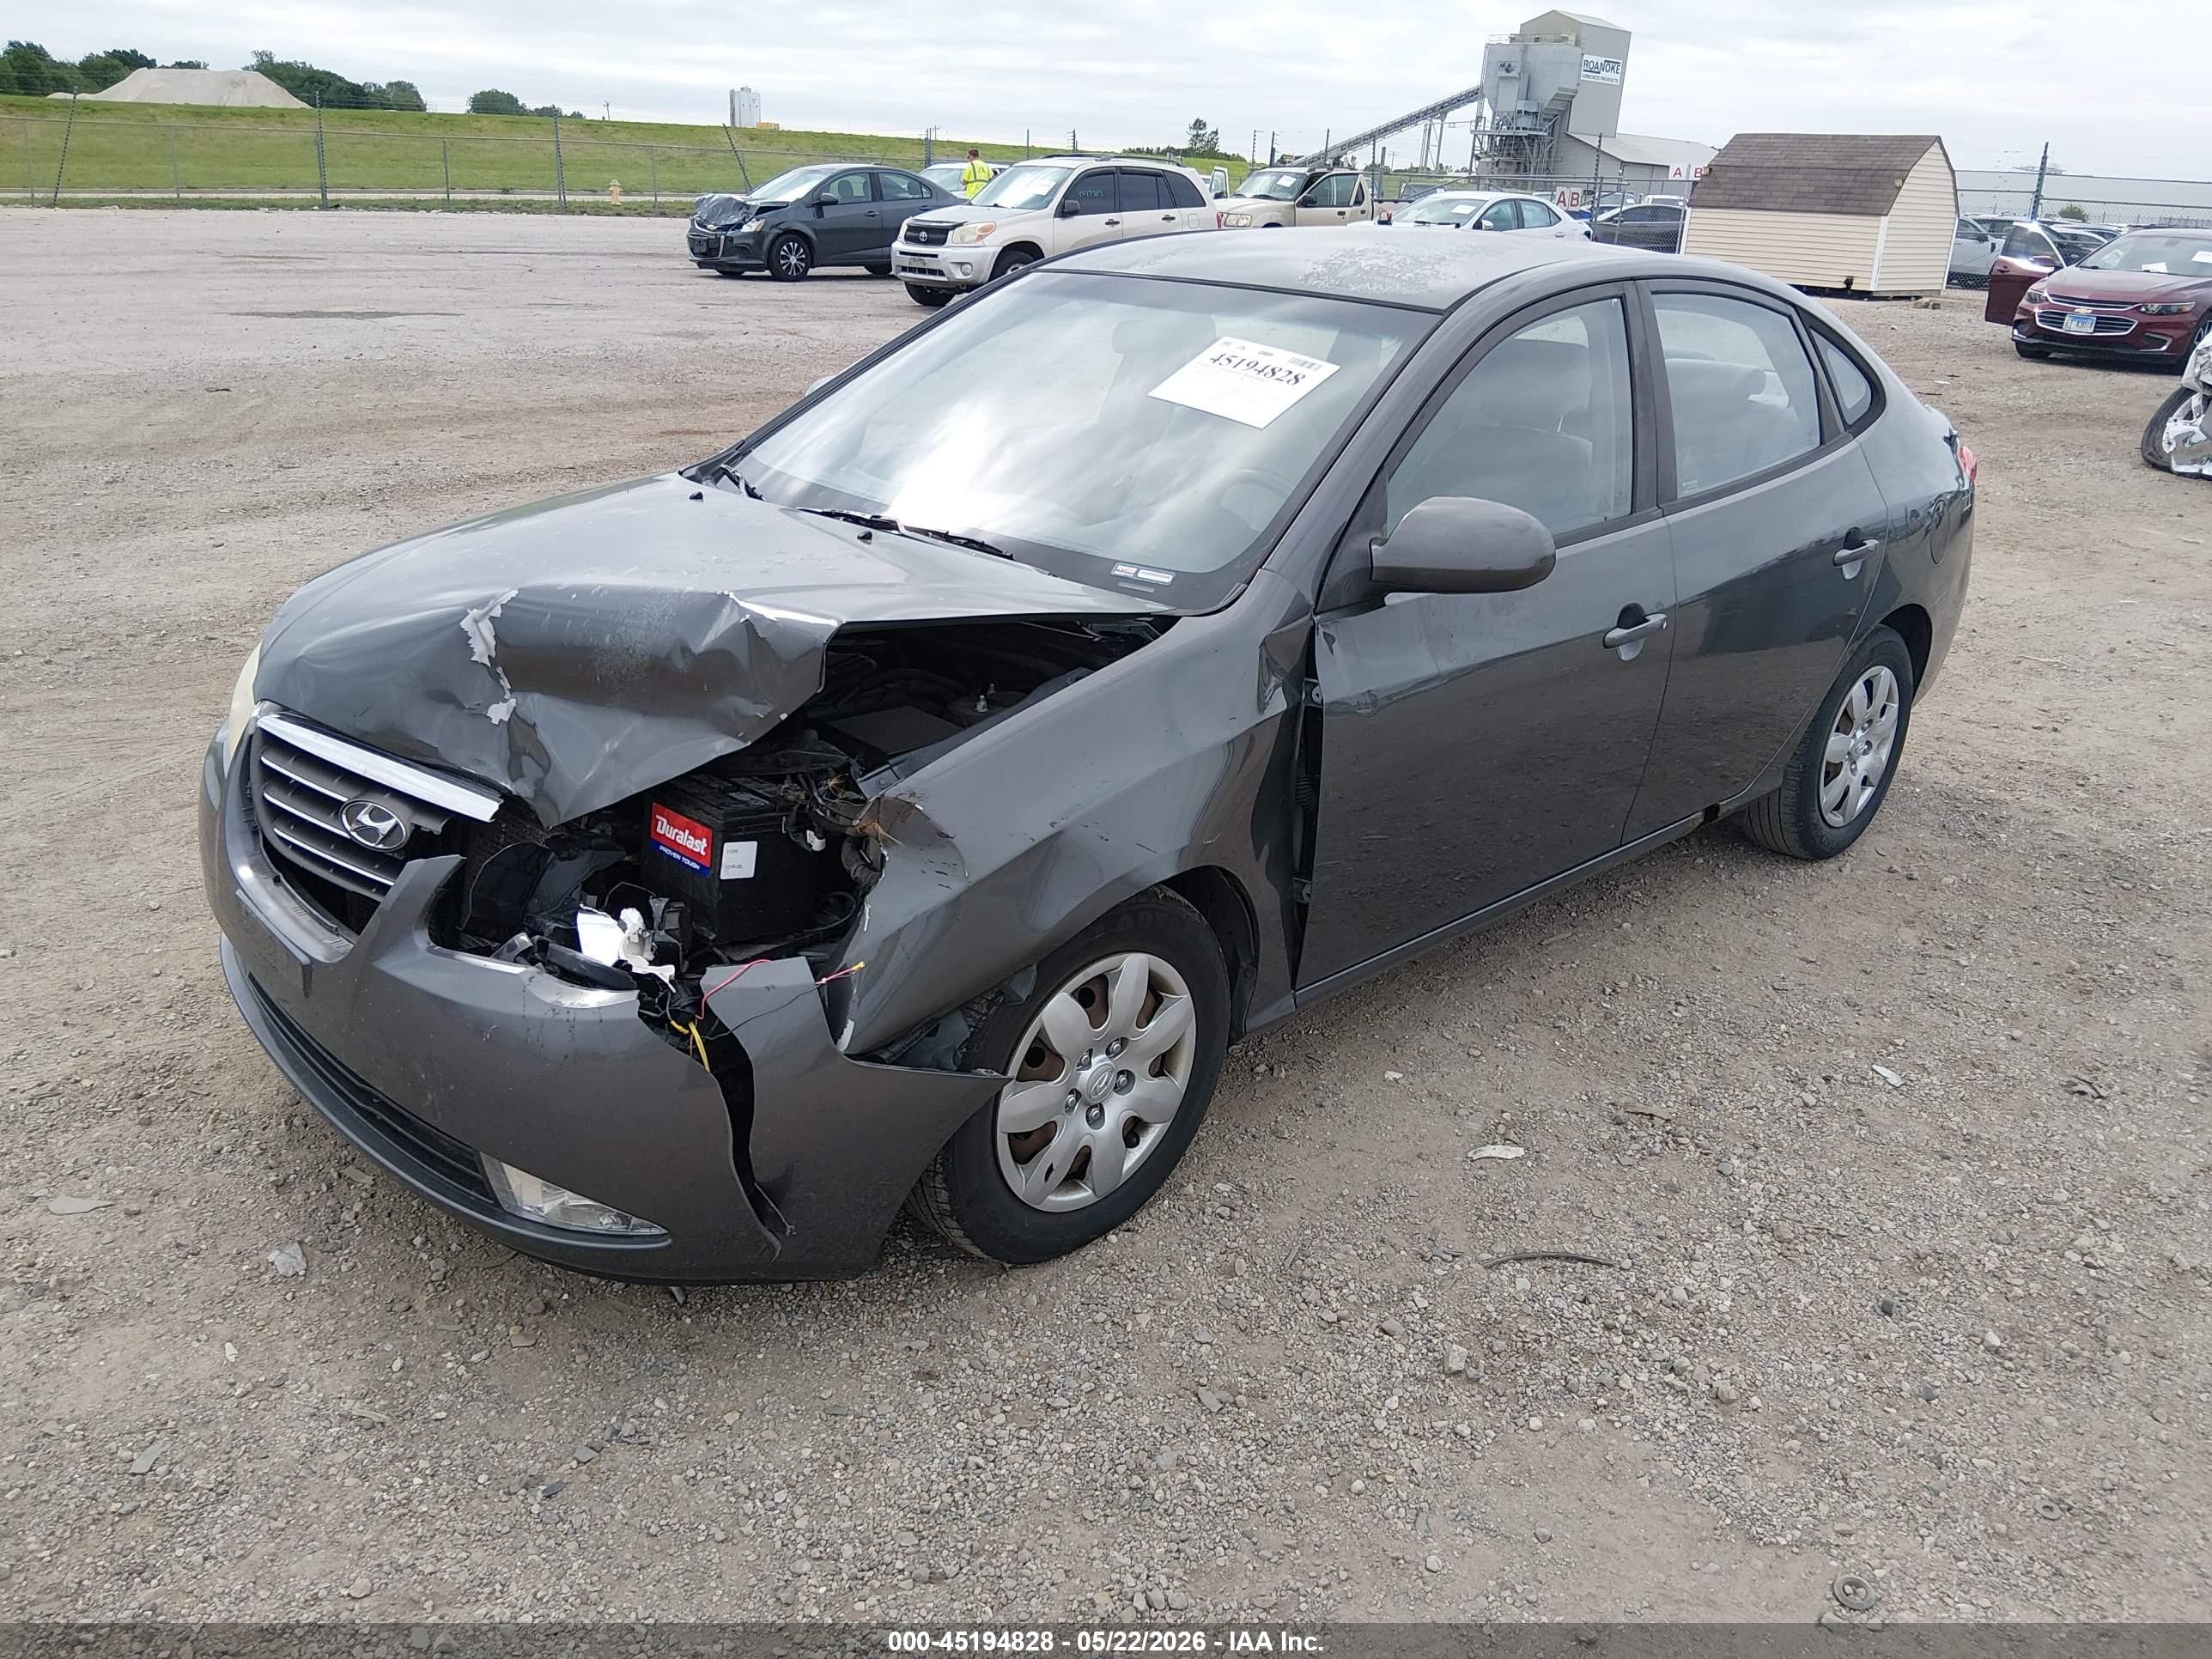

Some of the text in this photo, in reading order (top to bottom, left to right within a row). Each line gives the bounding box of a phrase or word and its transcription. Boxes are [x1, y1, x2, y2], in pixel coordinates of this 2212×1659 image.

[1583, 59, 1621, 75] ROANOKE
[1673, 167, 1703, 178] A B
[1556, 191, 1580, 207] A B
[1209, 353, 1306, 386] 45194828
[655, 814, 708, 855] Duralast
[659, 845, 701, 871] PROVEN TOUGH
